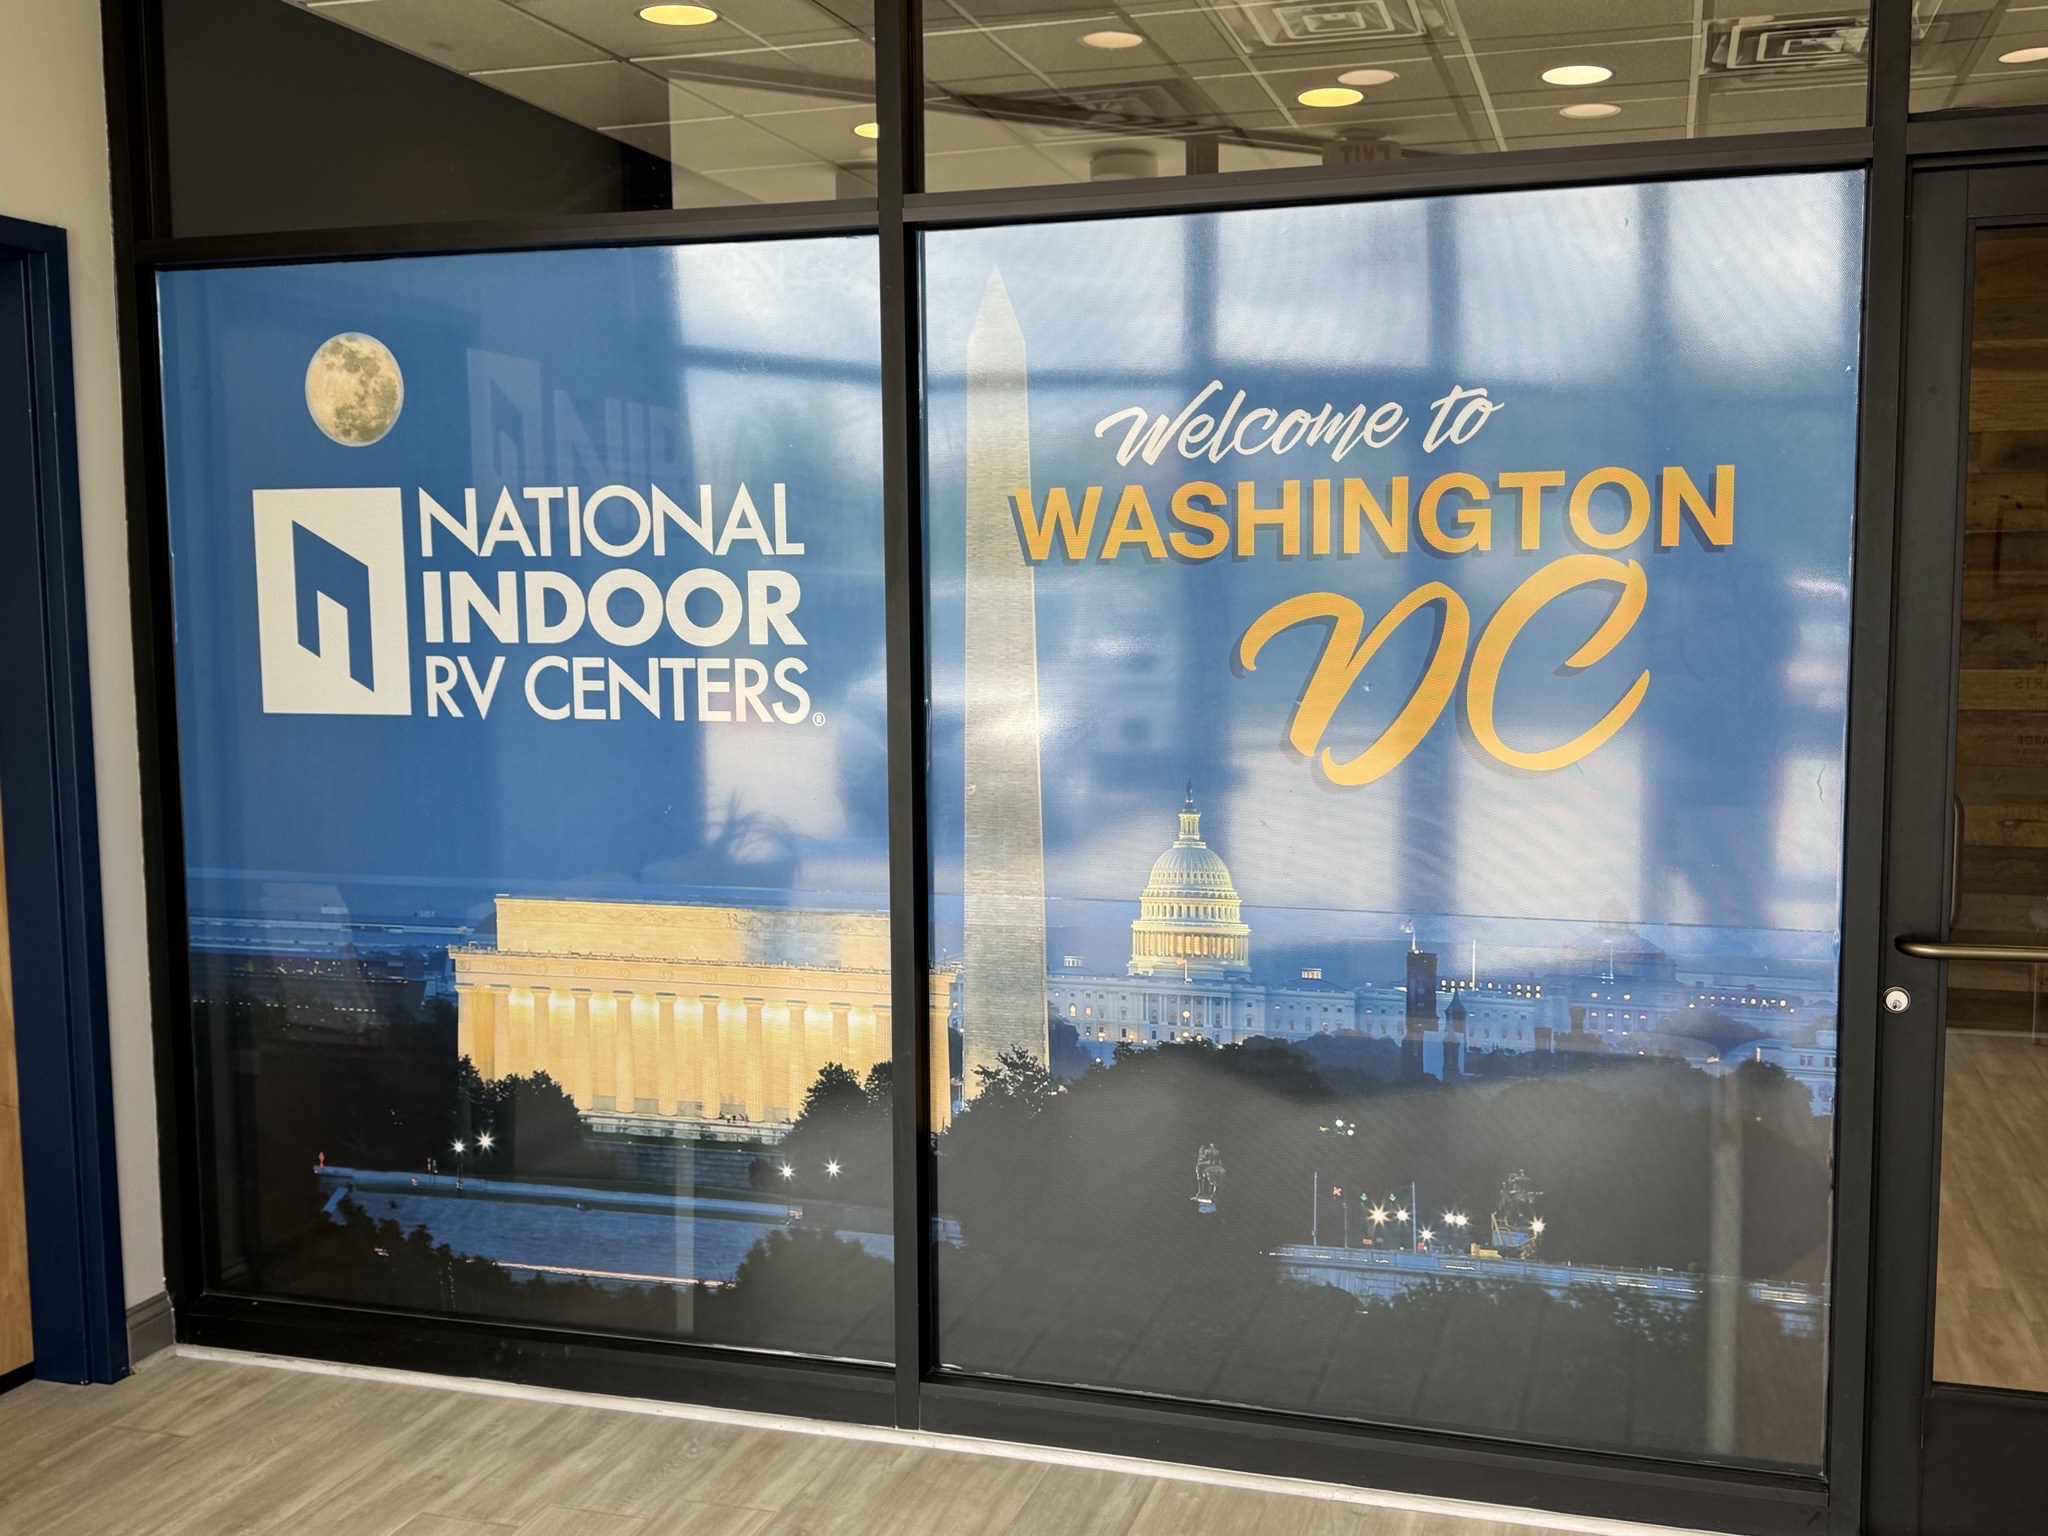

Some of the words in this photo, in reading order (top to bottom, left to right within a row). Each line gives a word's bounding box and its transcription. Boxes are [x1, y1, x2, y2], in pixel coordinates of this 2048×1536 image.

[1095, 380, 1408, 467] Welcome
[1423, 385, 1505, 453] to
[418, 482, 805, 557] NATIONAL
[1010, 464, 1736, 562] WASHINGTON
[422, 567, 808, 647] INDOOR
[426, 655, 506, 720] RV
[1239, 553, 1652, 787] DC
